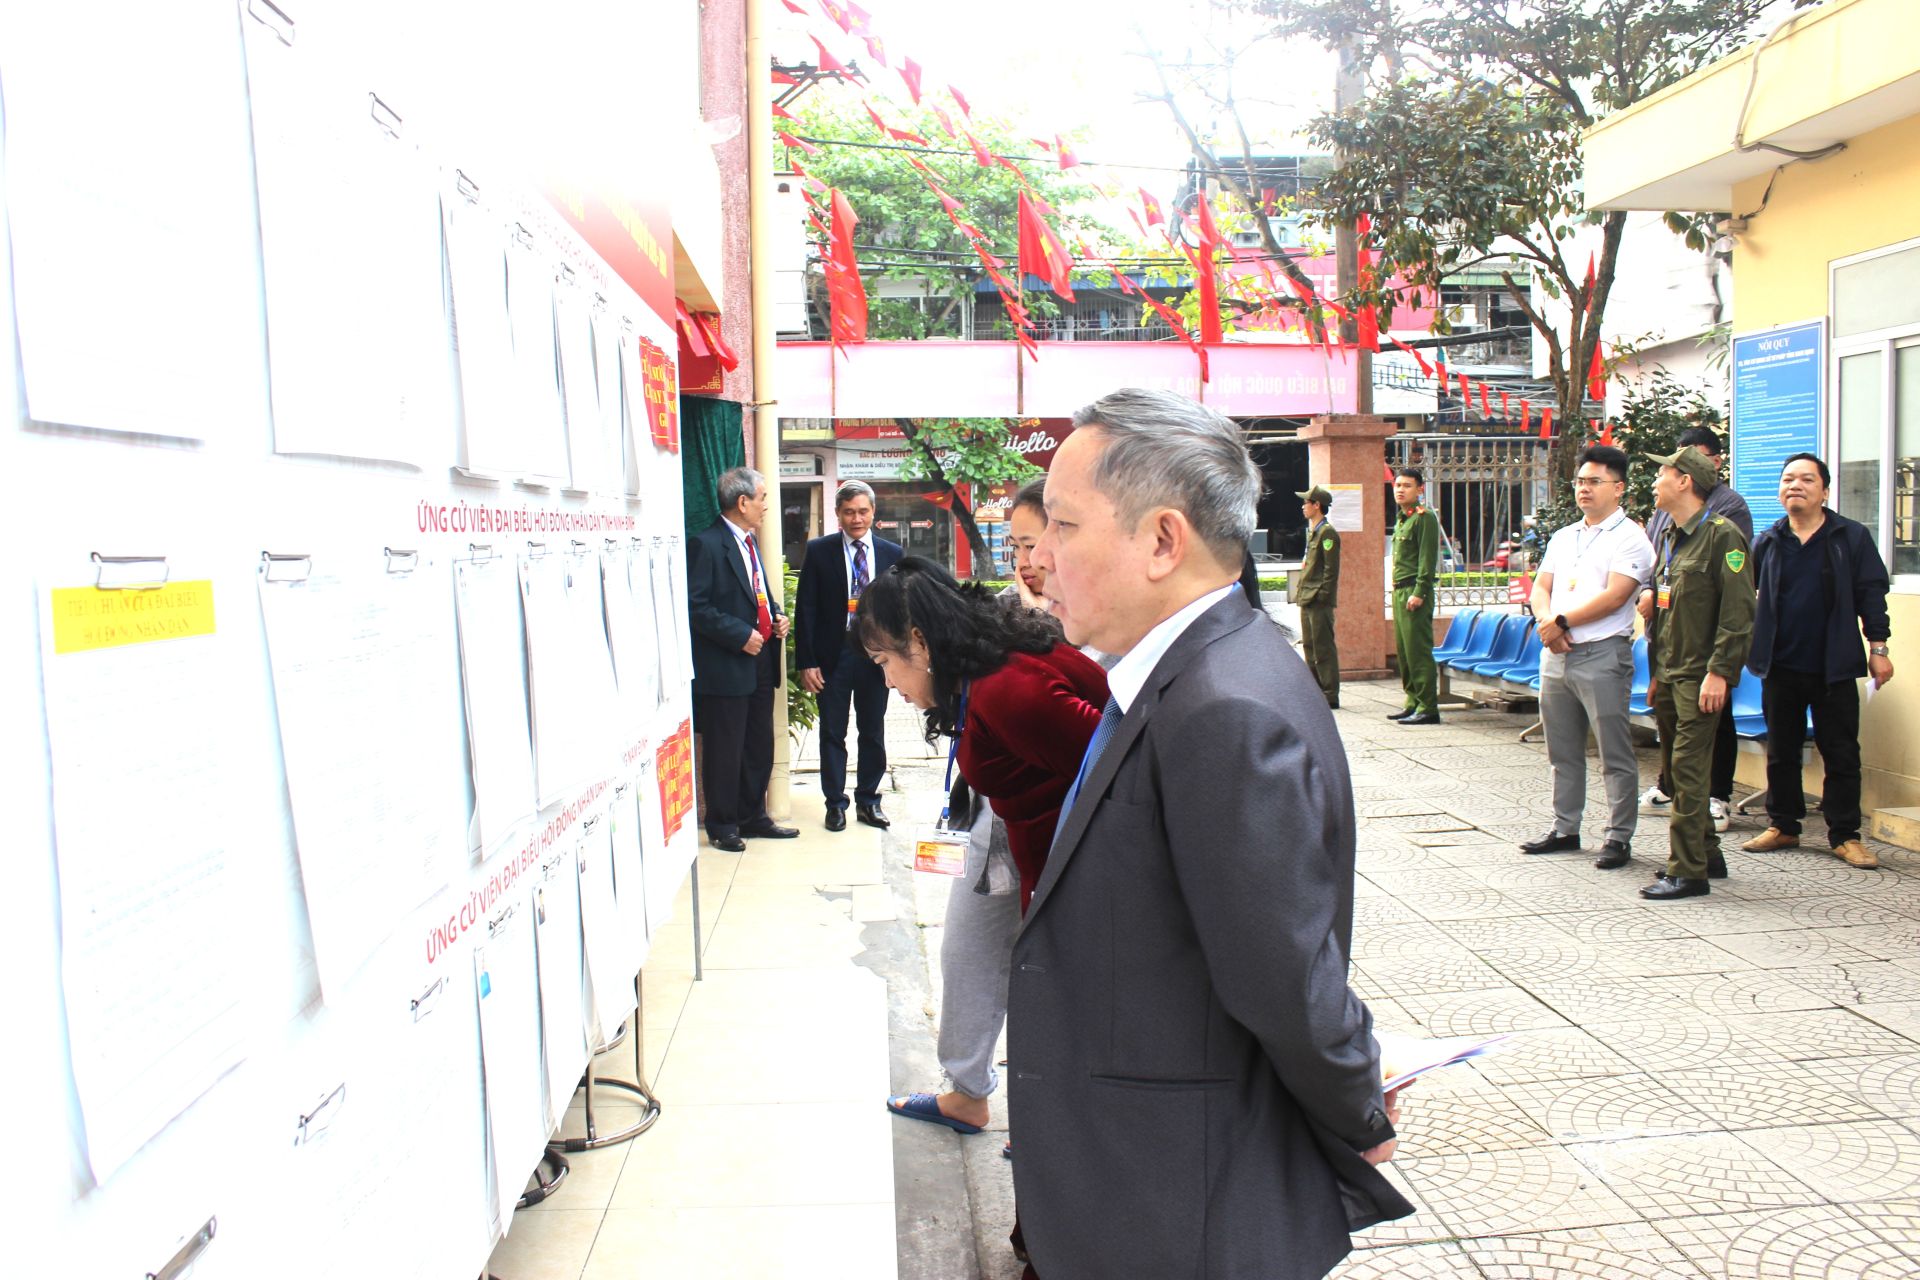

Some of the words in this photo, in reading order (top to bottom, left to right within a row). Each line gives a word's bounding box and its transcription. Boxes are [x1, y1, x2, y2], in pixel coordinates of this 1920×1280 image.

[1773, 337, 1790, 351] QUY
[1000, 430, 1059, 454] Hello
[417, 500, 448, 533] ỨNG
[450, 499, 468, 533] CỬ
[469, 504, 494, 533] VIÊN
[494, 509, 513, 538] ĐẠI
[514, 503, 533, 533] BIỂU
[426, 914, 458, 964] ỨNG
[459, 889, 477, 932] CỬ
[479, 875, 502, 914] VIÊN
[503, 856, 520, 890] ĐẠI
[521, 833, 540, 873] BIỂU
